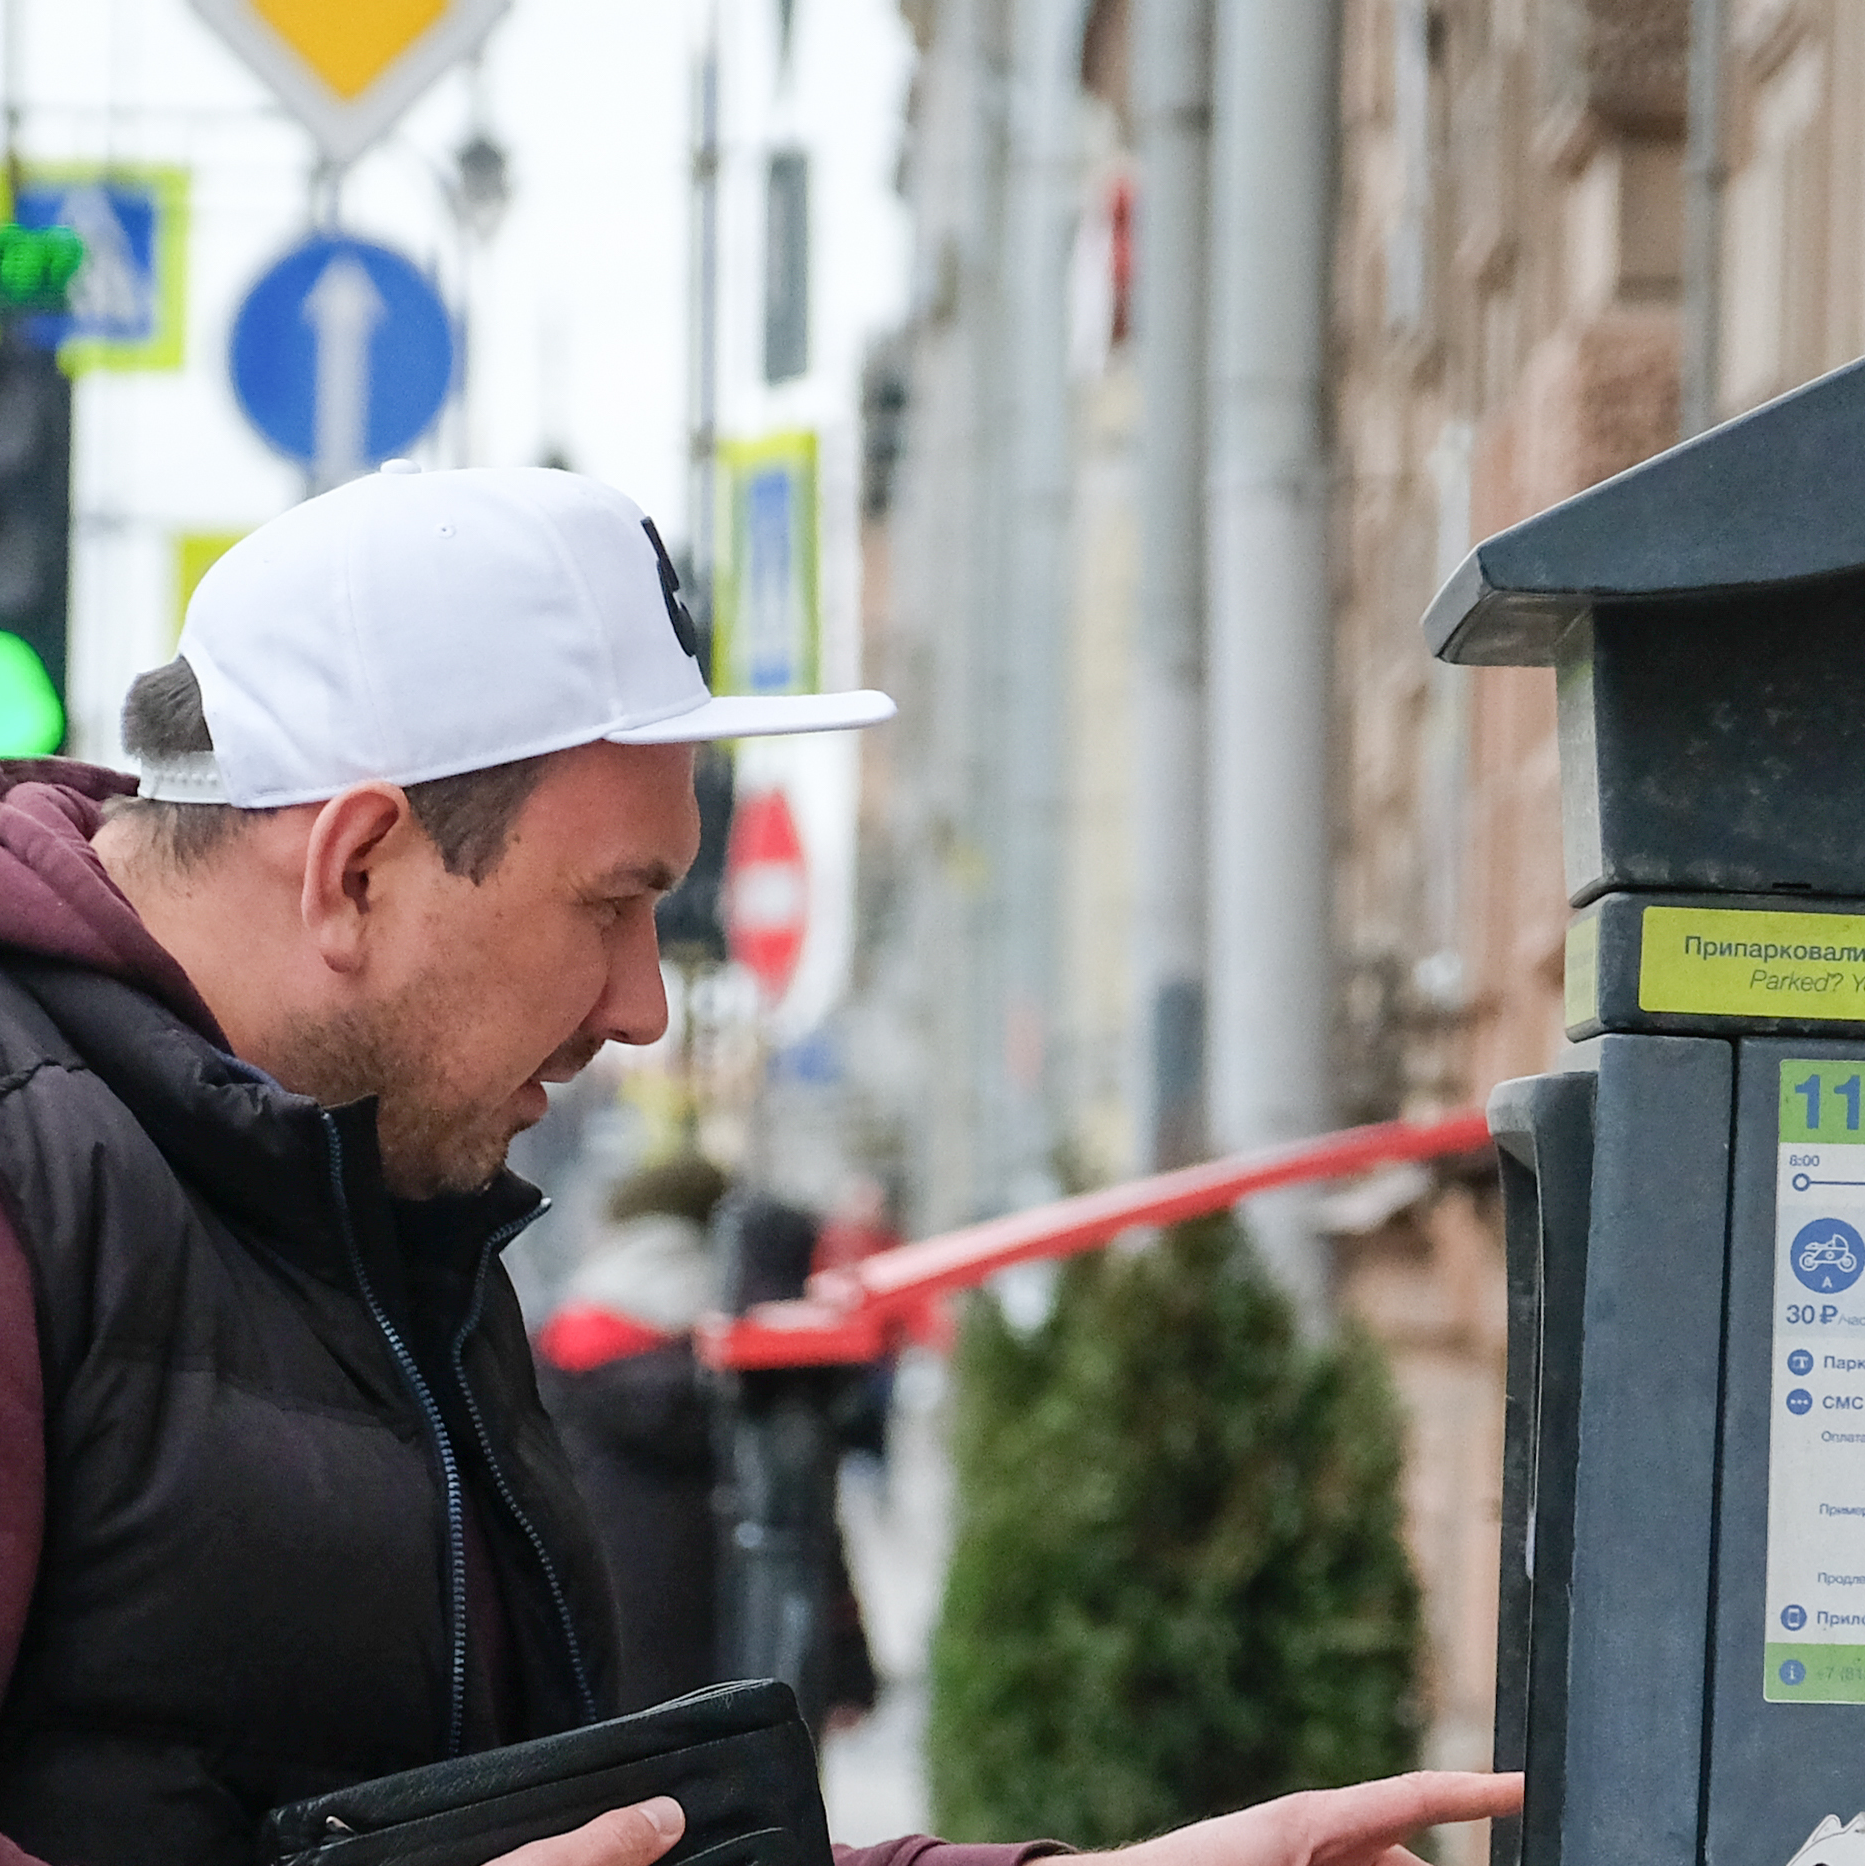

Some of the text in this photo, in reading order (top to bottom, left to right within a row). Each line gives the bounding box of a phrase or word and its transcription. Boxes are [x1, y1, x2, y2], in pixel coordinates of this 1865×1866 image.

[1750, 969, 1844, 992] Parked?
[1789, 1155, 1820, 1167] 8:00
[1821, 1277, 1833, 1289] A
[1786, 1304, 1816, 1325] 30
[1822, 1395, 1864, 1410] СМС
